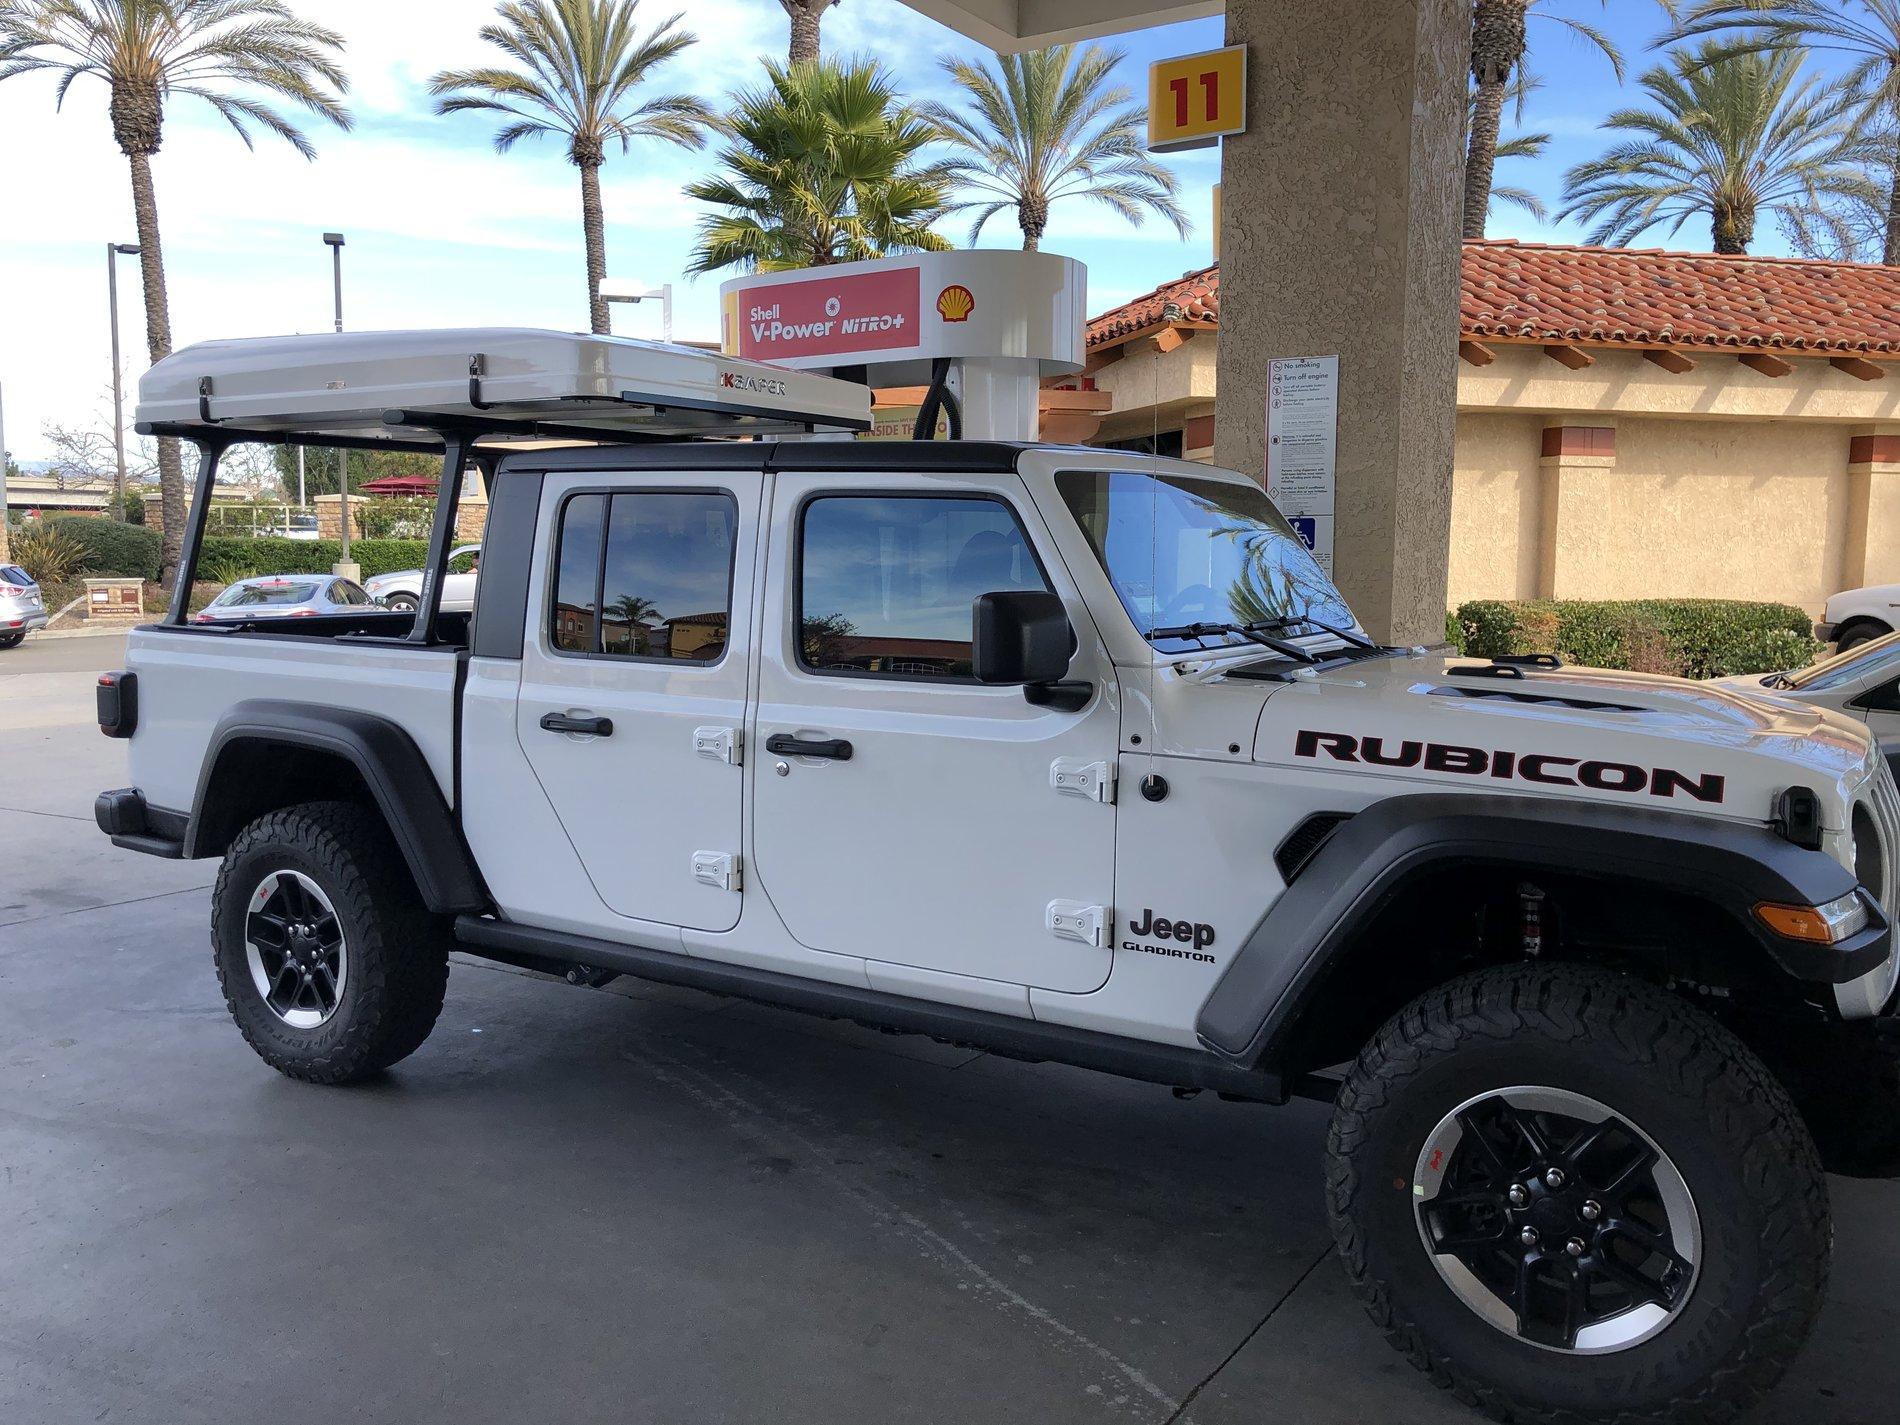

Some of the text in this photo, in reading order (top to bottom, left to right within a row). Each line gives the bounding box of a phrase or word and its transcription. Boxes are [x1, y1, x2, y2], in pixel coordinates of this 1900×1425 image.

[1169, 71, 1218, 127] 11
[750, 304, 780, 322] Shell
[750, 320, 834, 343] V-Power
[1294, 729, 1725, 804] RUBICON
[1129, 908, 1216, 951] Jeep
[1122, 941, 1216, 964] GLADIATOR
